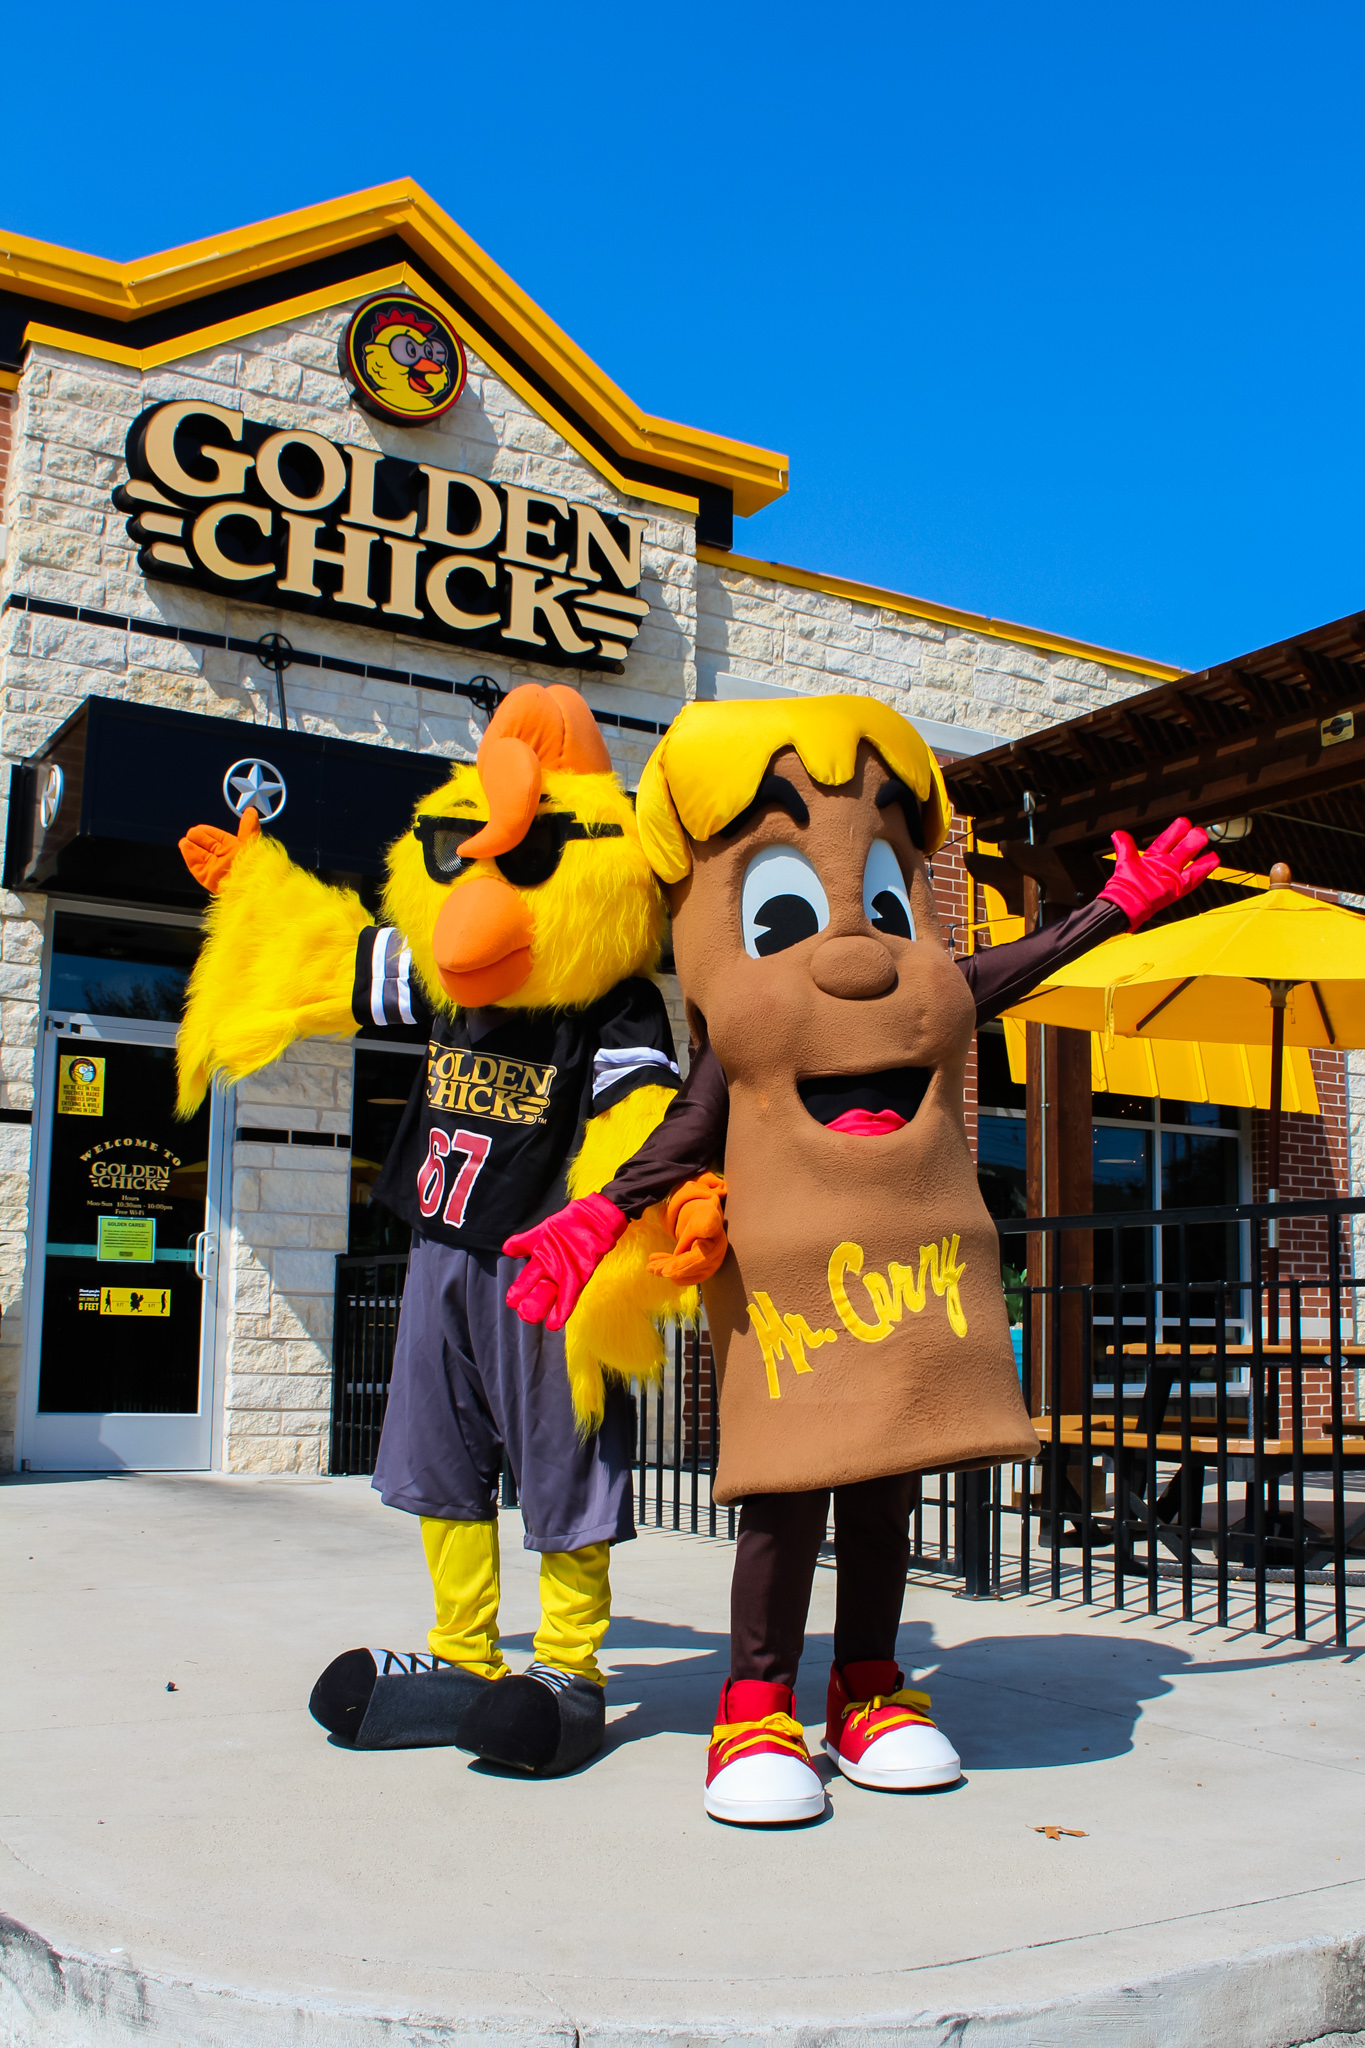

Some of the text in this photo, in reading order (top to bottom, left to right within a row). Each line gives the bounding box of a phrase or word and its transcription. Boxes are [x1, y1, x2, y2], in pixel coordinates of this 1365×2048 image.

[145, 400, 648, 588] GOLDEN
[192, 501, 595, 654] CHICK
[80, 1138, 181, 1166] WELCOME TO
[91, 1161, 170, 1179] GOLDEN
[98, 1176, 160, 1191] CHICK
[417, 1127, 493, 1228] 67
[78, 1302, 100, 1311] 6 FEET
[746, 1291, 838, 1399] Mr.
